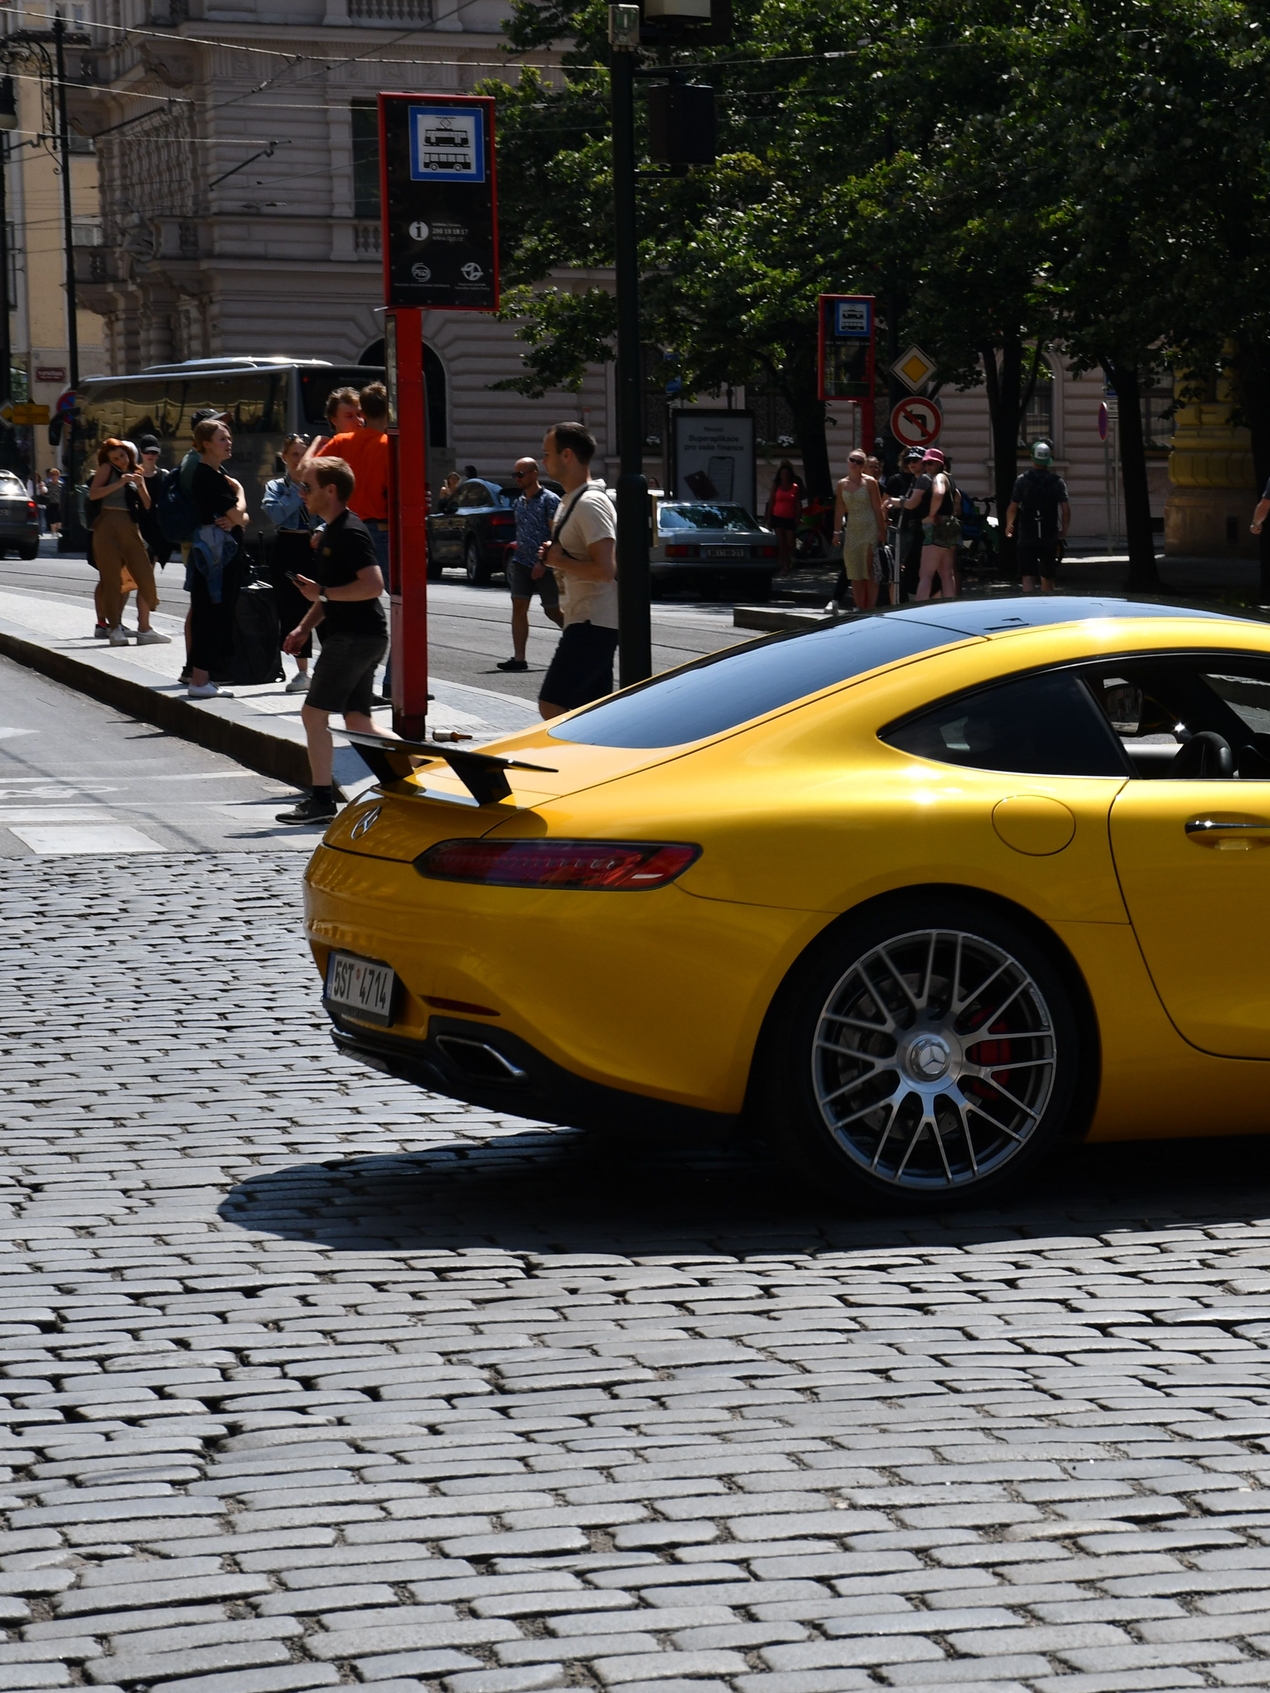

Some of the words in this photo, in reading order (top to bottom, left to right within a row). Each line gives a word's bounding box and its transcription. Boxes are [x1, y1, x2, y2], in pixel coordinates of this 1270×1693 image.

[688, 435, 740, 443] Superaplikace
[717, 443, 744, 451] finance
[333, 960, 355, 1000] 5ST
[359, 967, 388, 1010] 4714
